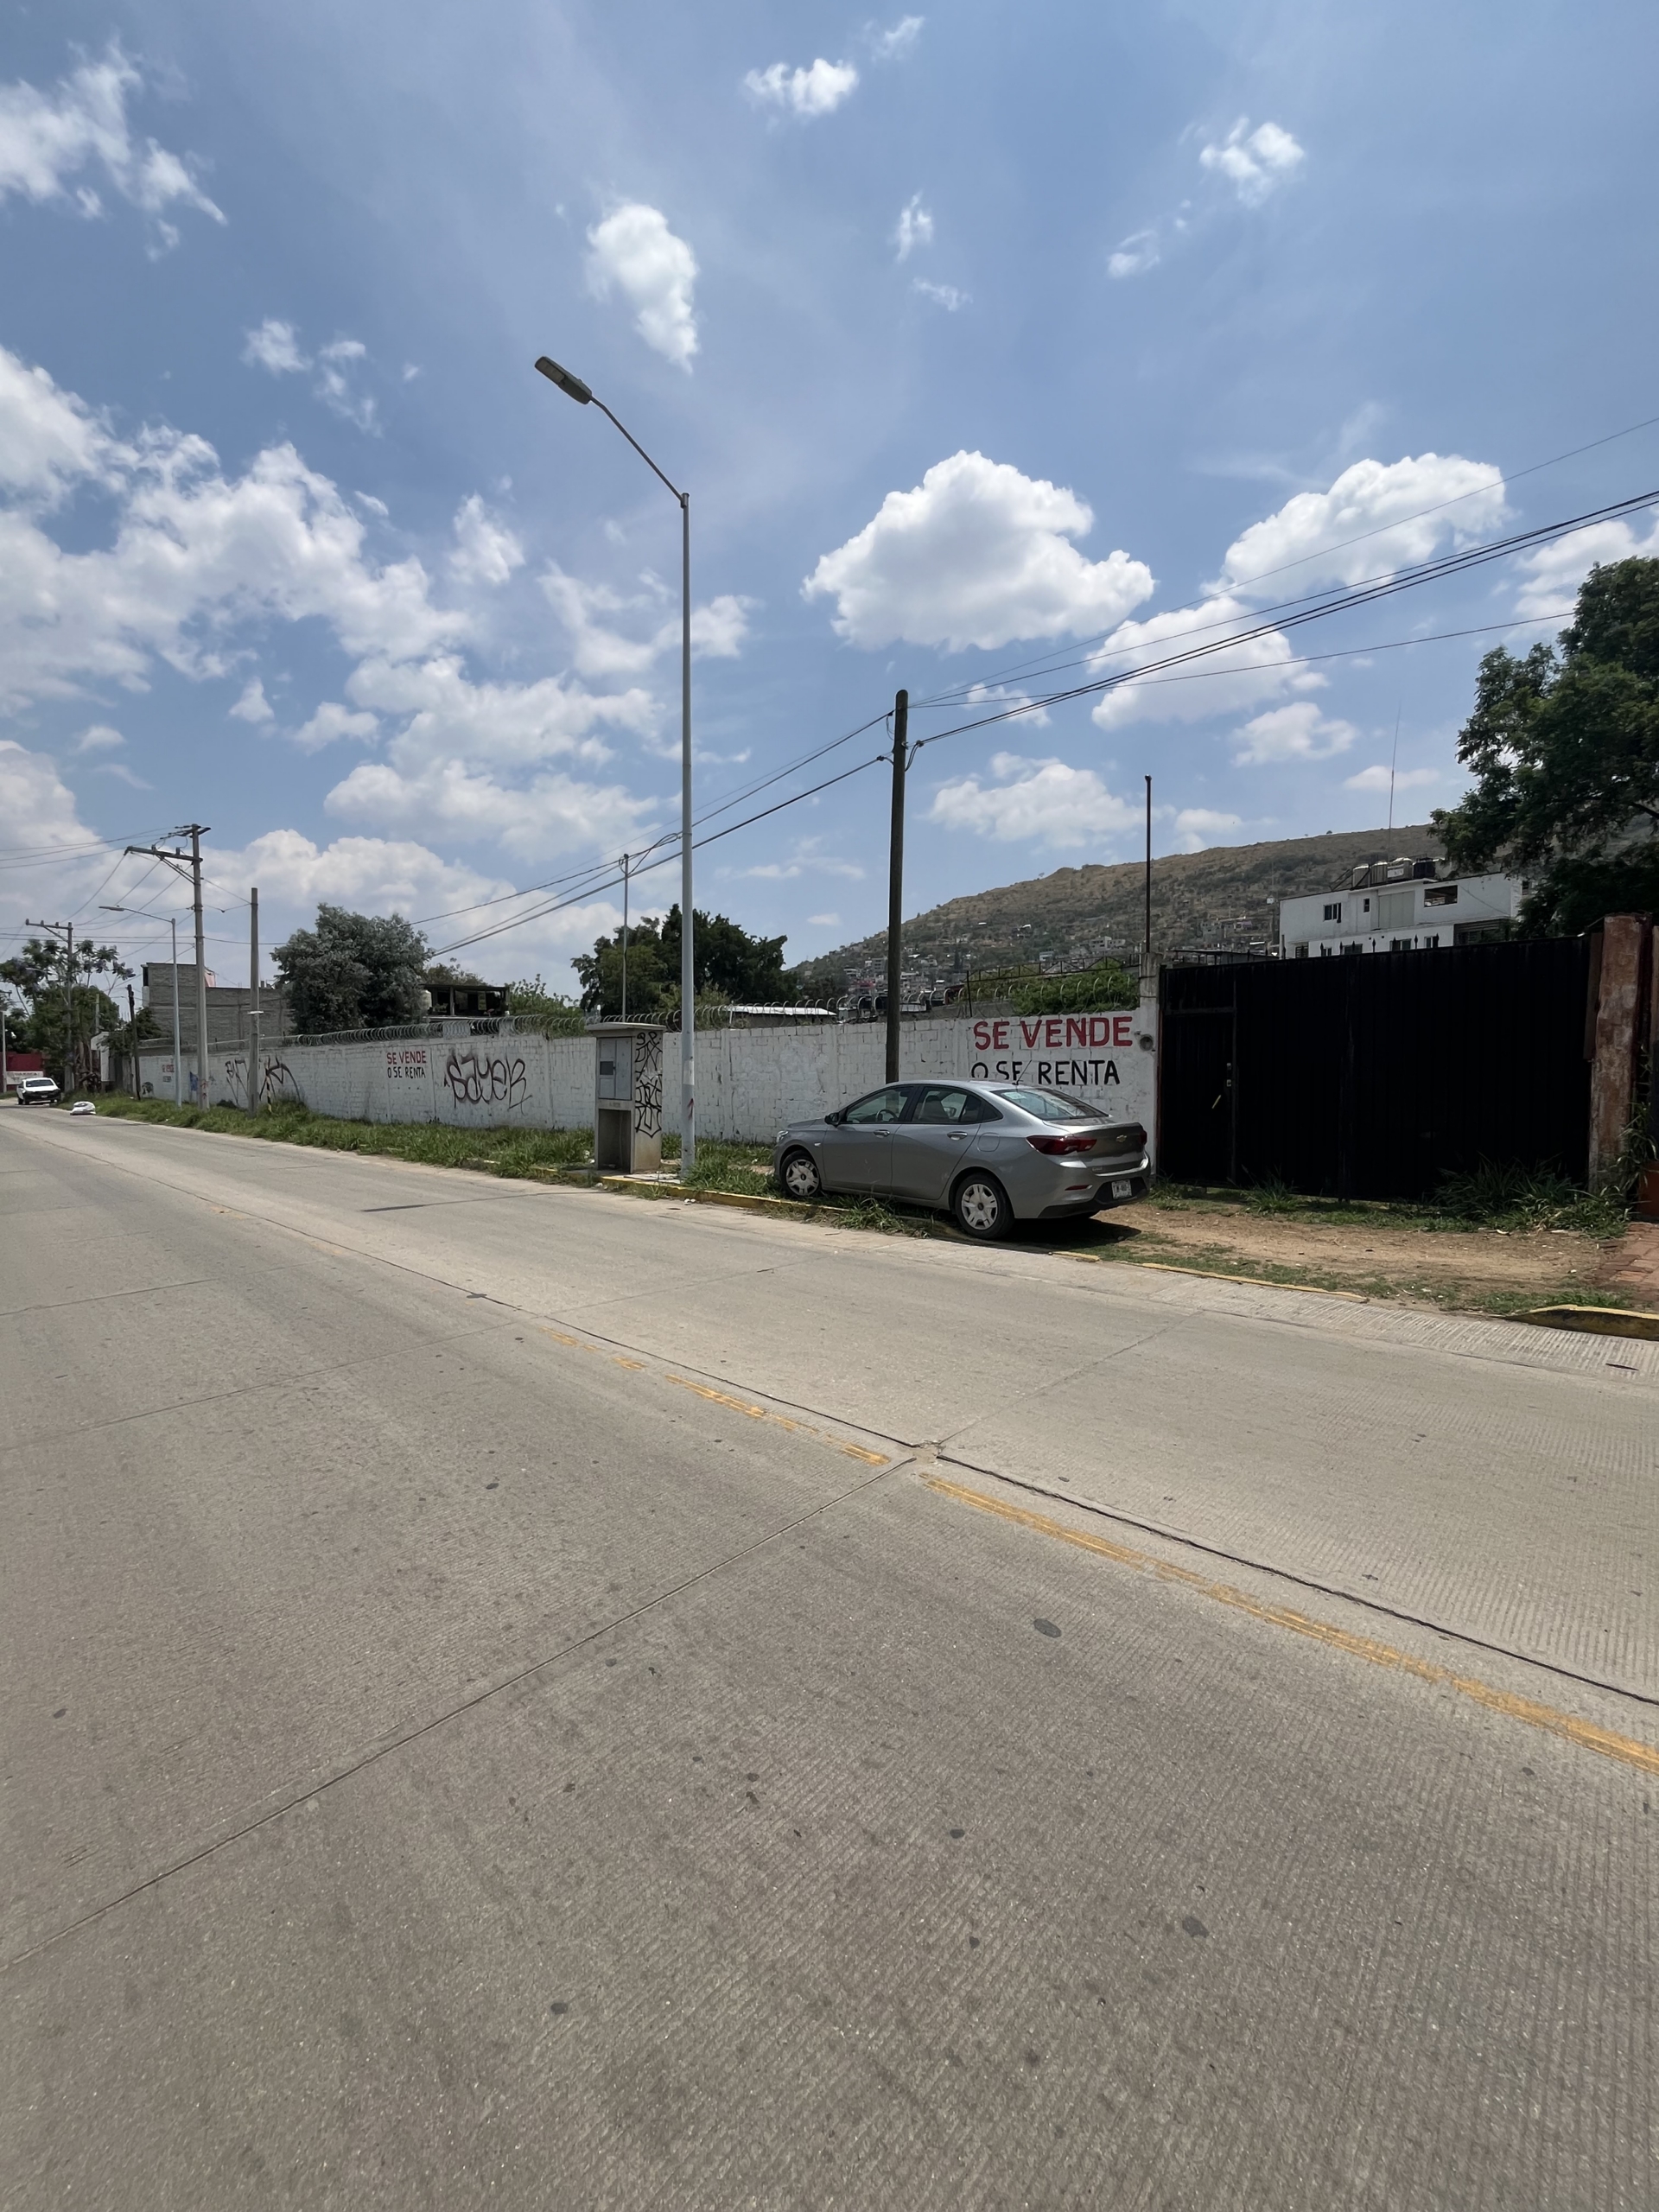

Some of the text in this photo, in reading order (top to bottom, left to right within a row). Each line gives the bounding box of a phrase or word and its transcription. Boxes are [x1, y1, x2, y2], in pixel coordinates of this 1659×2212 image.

[973, 1016, 1133, 1051] SE VENDE
[386, 1051, 427, 1065] SE VENDE
[393, 1066, 403, 1078] SE
[404, 1066, 426, 1079] RENTA
[970, 1060, 1121, 1085] O SE RENTA
